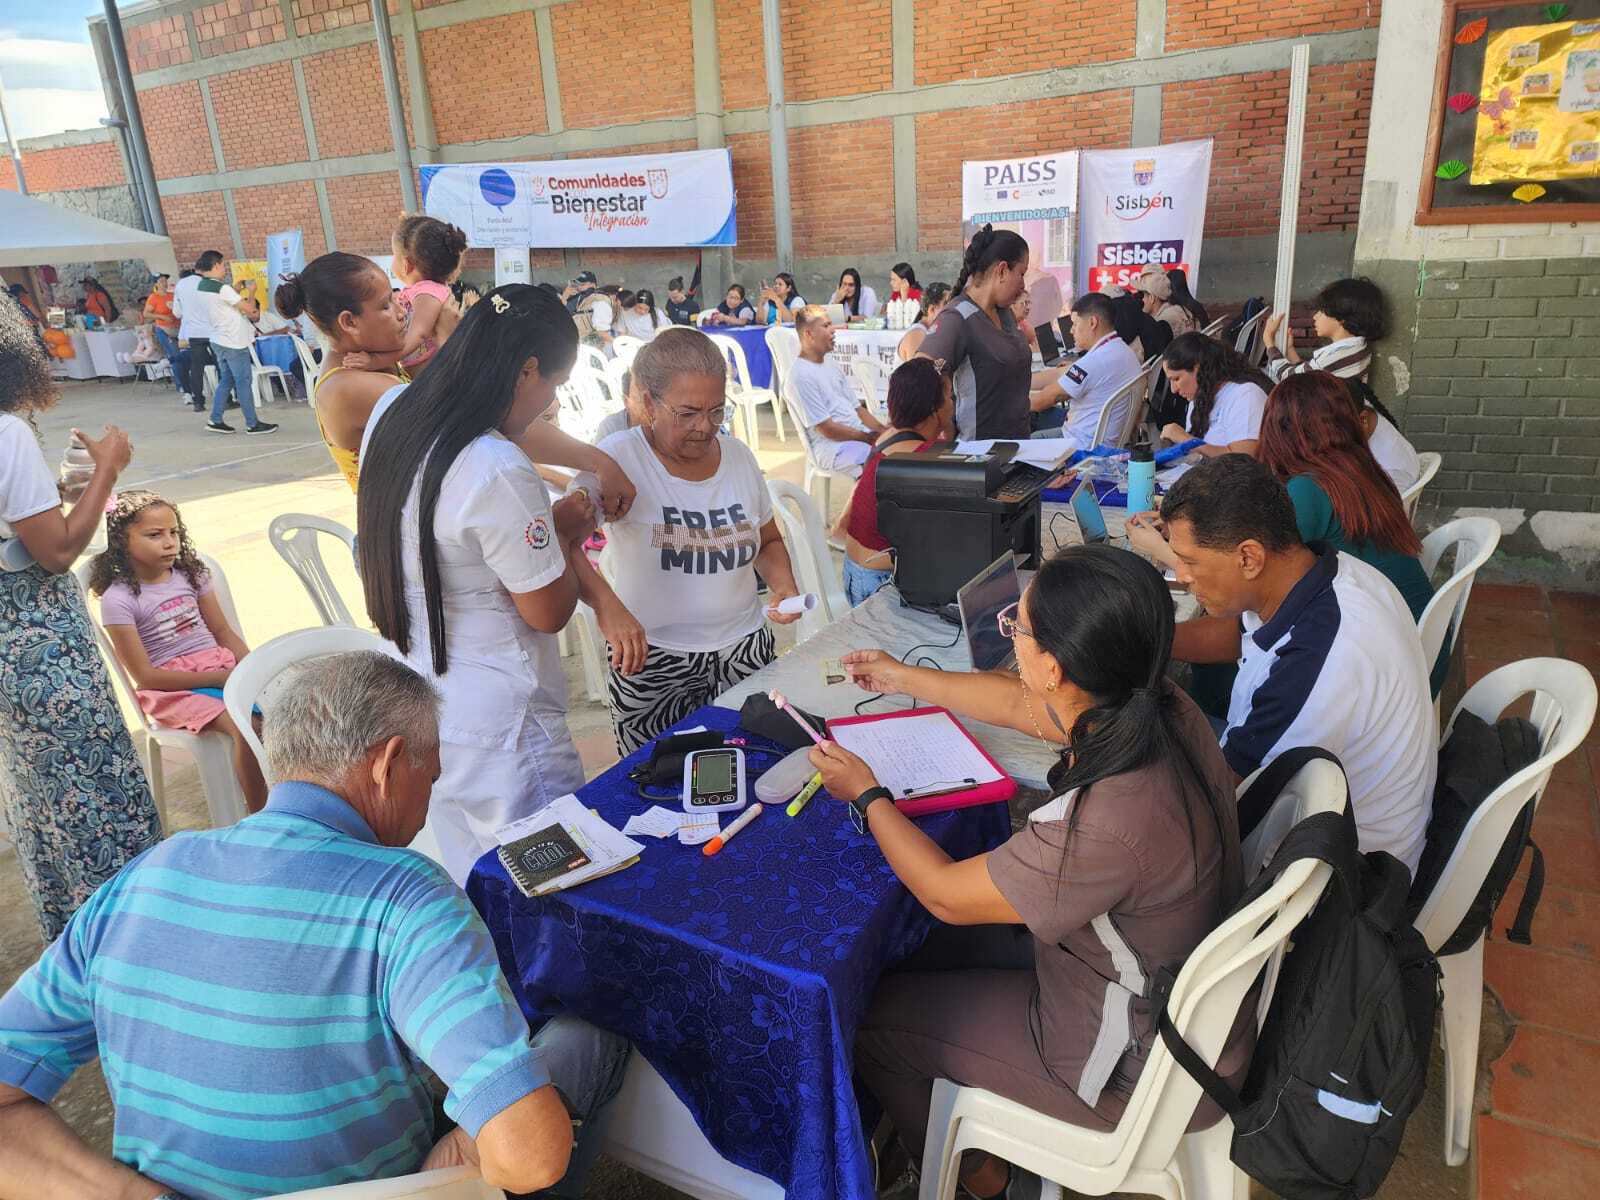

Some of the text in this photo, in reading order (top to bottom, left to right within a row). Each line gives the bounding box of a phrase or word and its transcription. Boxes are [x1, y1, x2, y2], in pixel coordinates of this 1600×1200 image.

[548, 172, 646, 190] Comunidades
[984, 159, 1056, 186] PAISS
[551, 191, 647, 214] Bienestar
[1115, 191, 1173, 210] Sisbén
[1103, 243, 1177, 265] Sisbén
[661, 503, 752, 540] FREE
[660, 540, 757, 575] MIND
